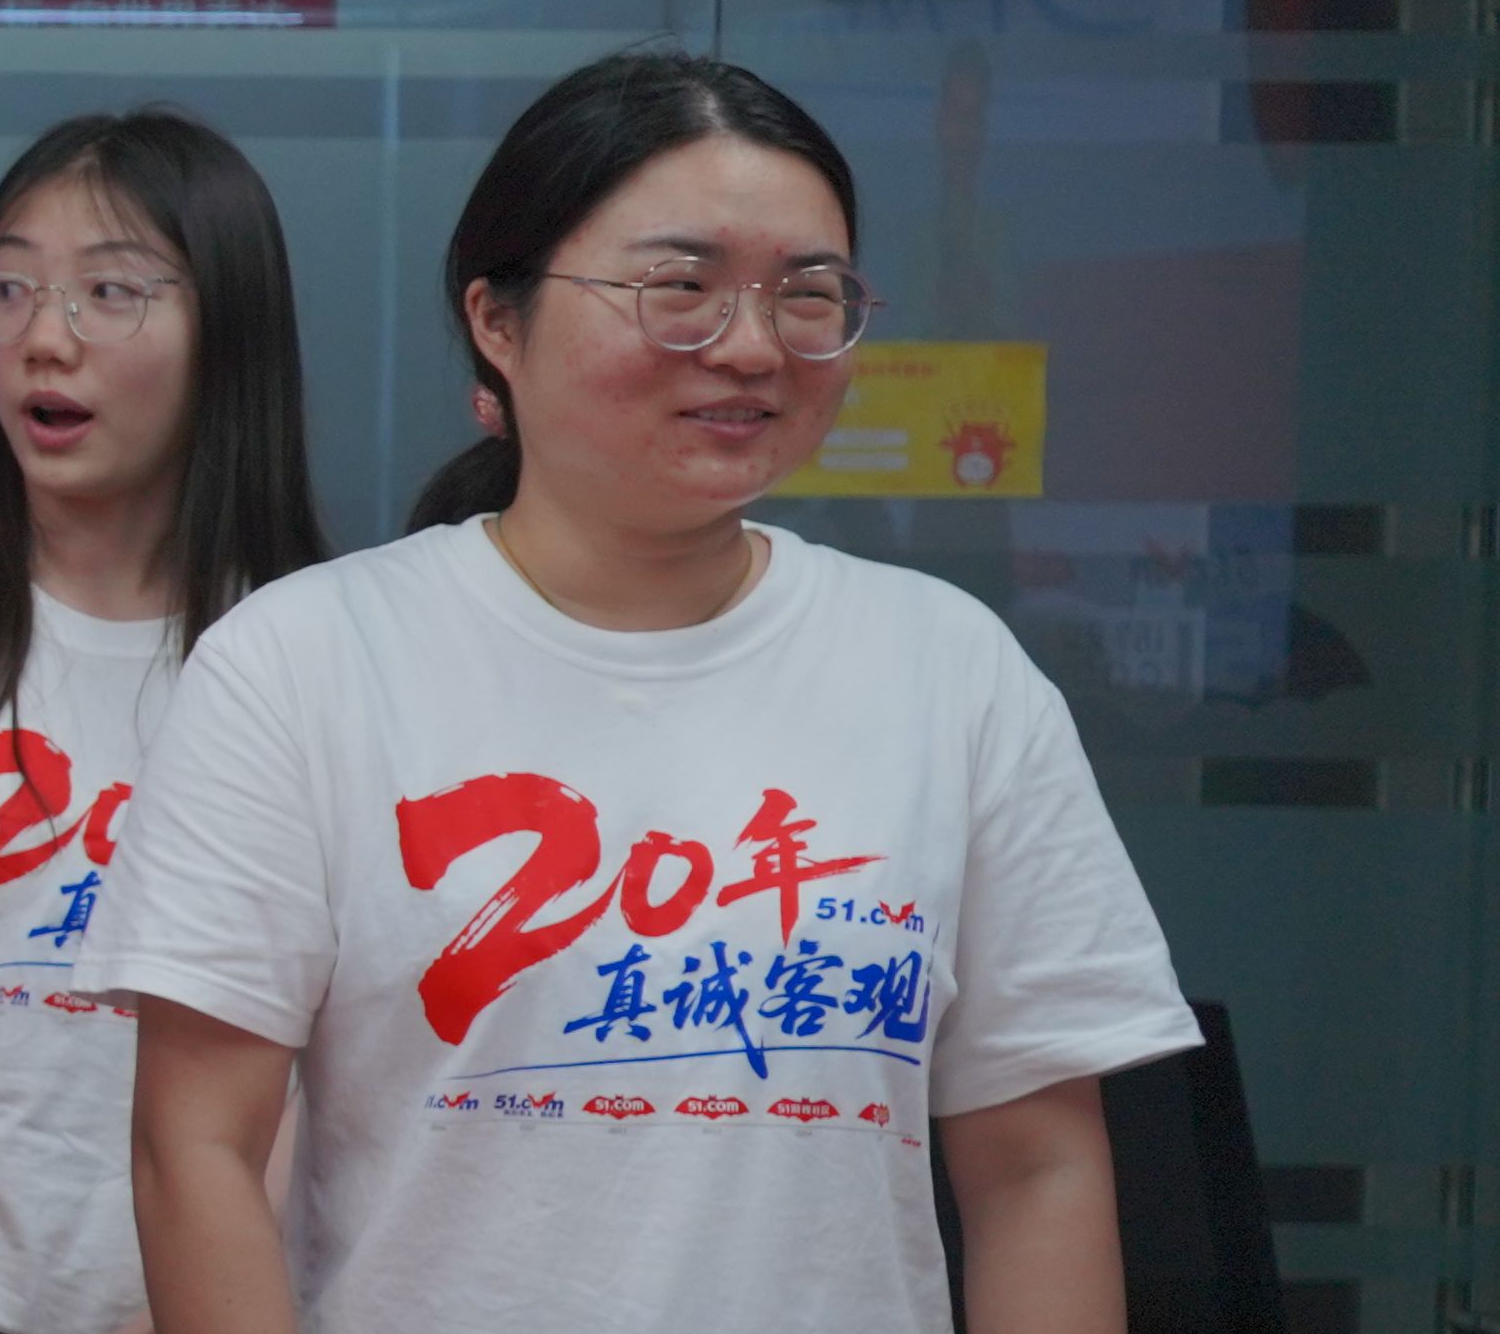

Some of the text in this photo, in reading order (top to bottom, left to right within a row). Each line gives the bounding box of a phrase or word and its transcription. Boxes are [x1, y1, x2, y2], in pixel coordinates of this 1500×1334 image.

[396, 772, 889, 1046] 20年
[563, 940, 930, 1079] 真诚客观
